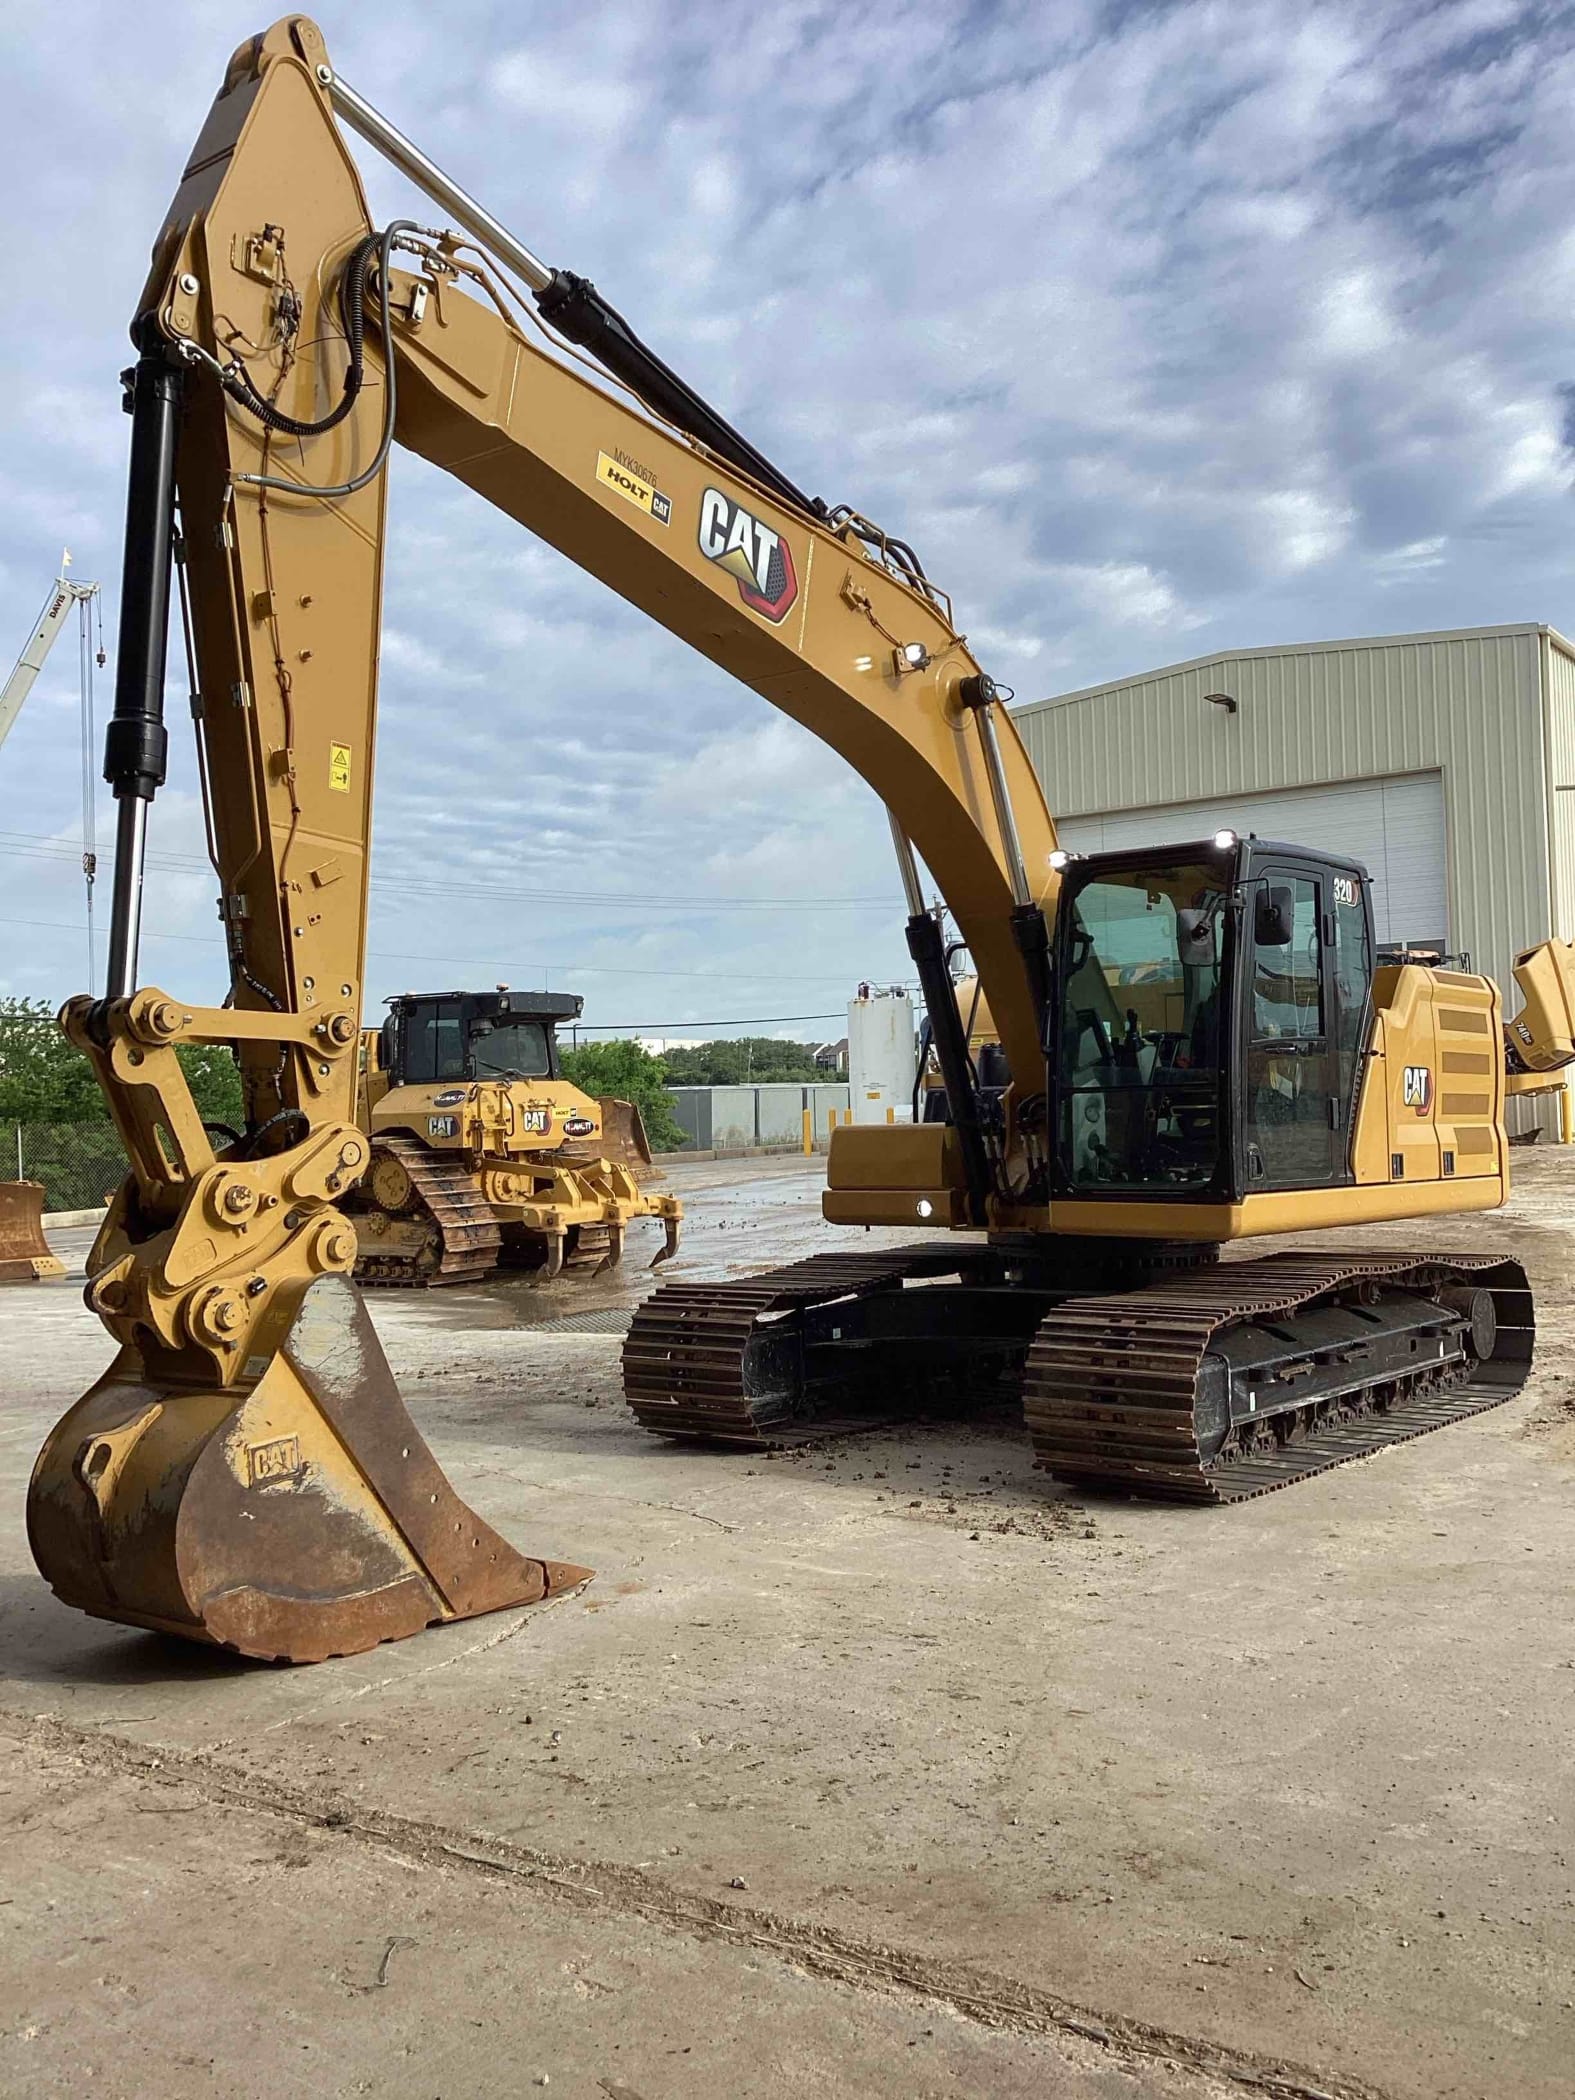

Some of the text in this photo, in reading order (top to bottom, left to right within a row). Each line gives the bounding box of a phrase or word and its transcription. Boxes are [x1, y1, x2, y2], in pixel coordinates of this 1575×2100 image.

[614, 447, 658, 488] MYK30676
[607, 467, 669, 517] HOLT CAT
[699, 487, 779, 594] CAT
[50, 594, 66, 619] DAVIS
[1333, 877, 1353, 903] 320
[1514, 1021, 1530, 1039] 740
[1404, 1067, 1428, 1106] CAT
[428, 1116, 453, 1137] CAT
[523, 1110, 546, 1132] CAT
[254, 1440, 296, 1481] CAT
